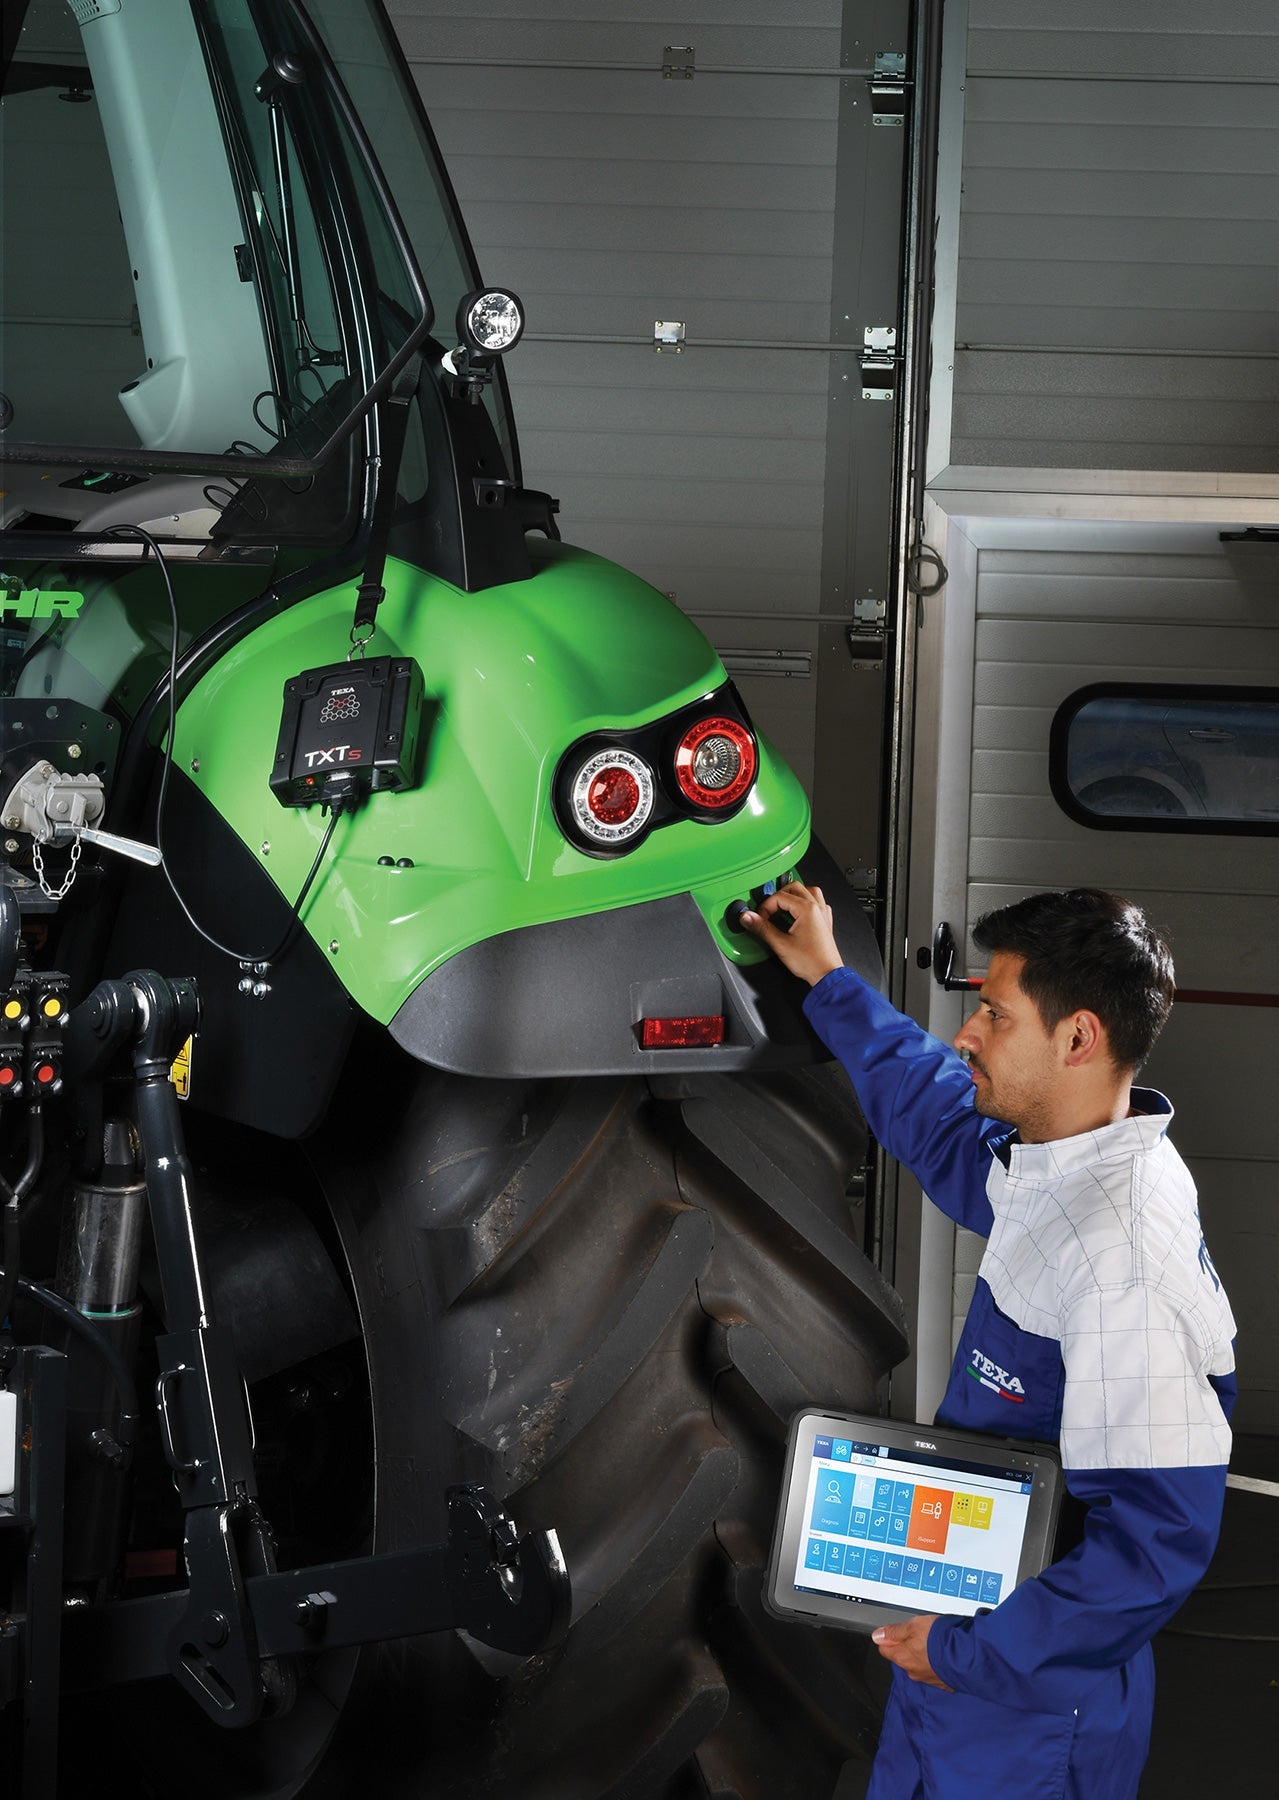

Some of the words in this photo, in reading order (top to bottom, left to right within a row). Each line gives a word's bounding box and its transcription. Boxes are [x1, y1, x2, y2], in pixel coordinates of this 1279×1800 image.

[331, 687, 355, 697] TEXA
[971, 1348, 1026, 1395] TEXA
[914, 1441, 937, 1451] TEXA
